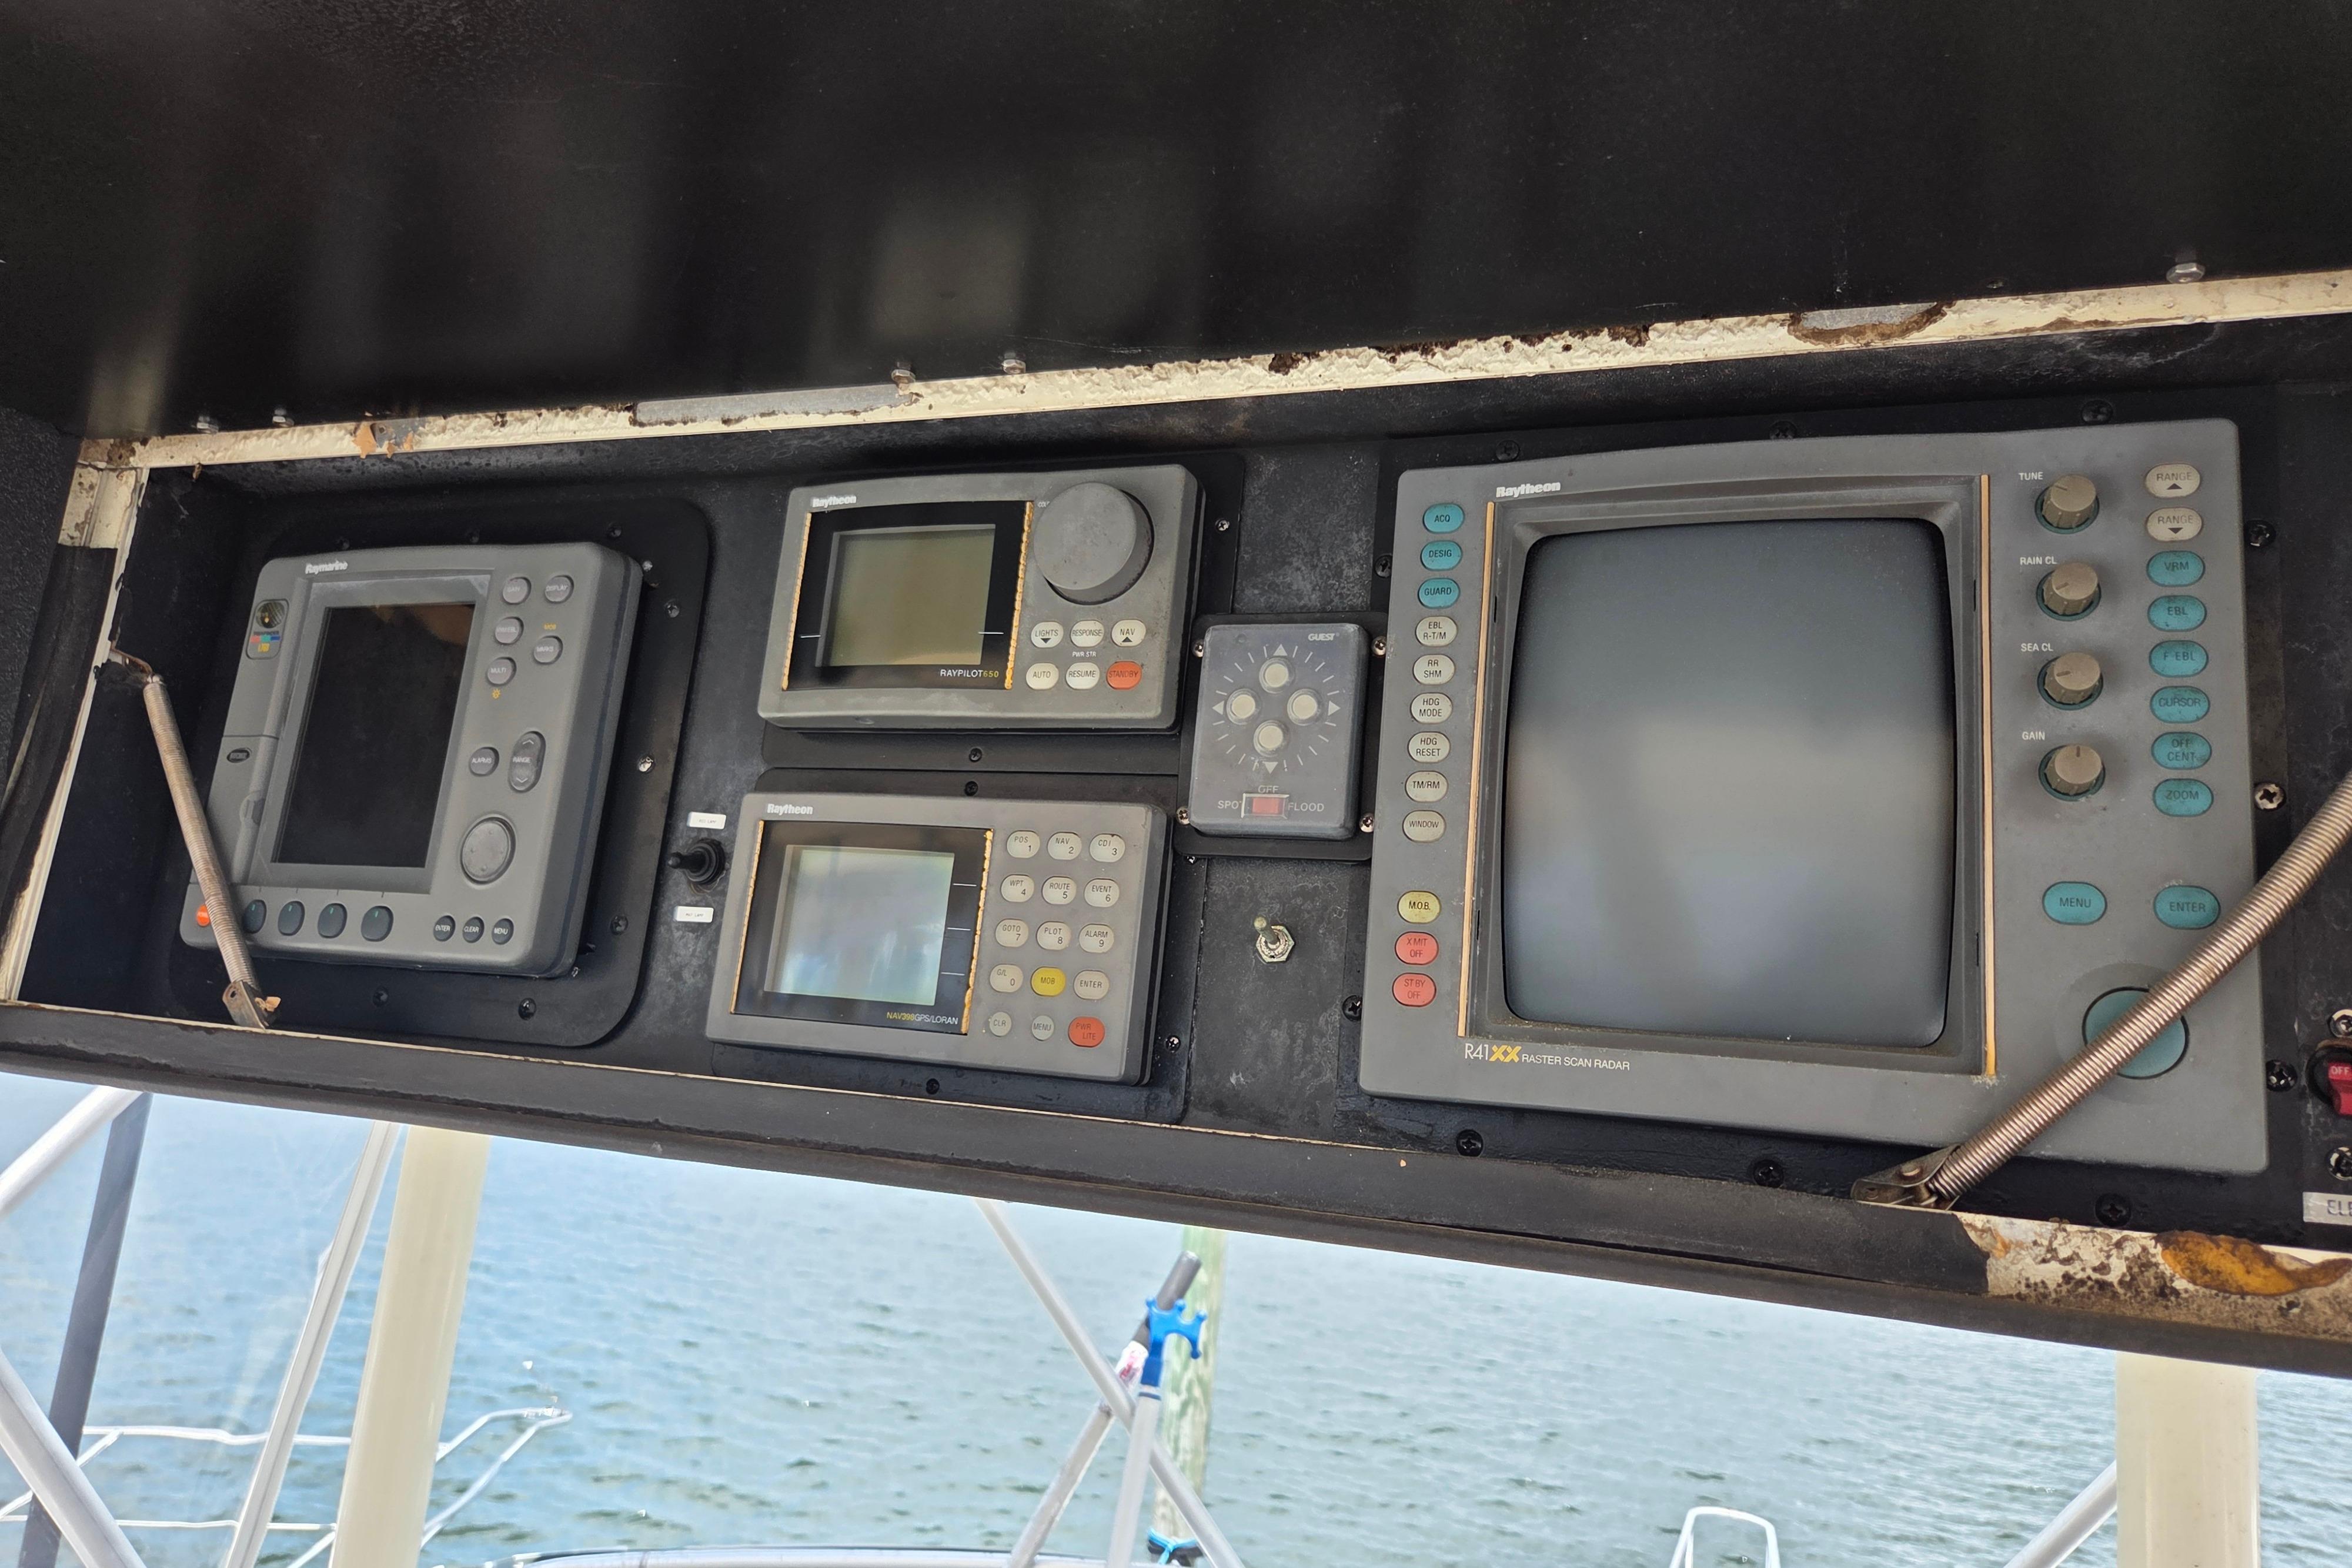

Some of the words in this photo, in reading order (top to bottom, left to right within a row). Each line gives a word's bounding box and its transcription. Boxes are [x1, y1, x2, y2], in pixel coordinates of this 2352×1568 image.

[2018, 472, 2043, 480] TUNE
[2156, 472, 2192, 481] RANGE
[1496, 482, 1561, 498] Raytheon
[812, 496, 857, 508] Raytheon
[1434, 514, 1451, 523] ACQ
[2157, 516, 2193, 524] RANGE
[1428, 550, 1452, 558] DESIG
[2020, 556, 2043, 565] RAIN
[2045, 556, 2057, 565] CL
[305, 560, 348, 574] Raymarine
[2164, 561, 2189, 570] VRM
[1424, 587, 1452, 596] GUARD
[2167, 606, 2188, 616] EBL
[1428, 621, 1443, 630] EBL
[1035, 629, 1058, 637] LIGHTS
[1423, 631, 1446, 641] R-T/M
[2021, 643, 2039, 652] SEA
[2041, 643, 2053, 652] CL
[1428, 660, 1439, 668] RR
[940, 669, 999, 677] RAYPILOT650
[1424, 670, 1442, 678] SHM
[1423, 698, 1439, 706] HDG
[2159, 697, 2201, 707] CURSOR
[1419, 708, 1442, 717] MODE
[2022, 731, 2046, 740] GAIN
[1420, 737, 1437, 746] HDG
[2171, 738, 2190, 748] OFF
[1416, 748, 1441, 757] RESET
[2167, 752, 2196, 761] CENT
[1258, 785, 1279, 793] OFF
[1412, 780, 1440, 789] TM/RM
[2166, 790, 2199, 800] ZOOM
[767, 803, 813, 815] Raytheon
[1217, 800, 1242, 809] SPO
[1288, 803, 1324, 811] FLOOD
[1409, 820, 1439, 828] WINDOW
[1408, 901, 1430, 911] M.O.B.
[2059, 897, 2092, 908] MENU
[2169, 901, 2206, 913] ENTER
[1409, 949, 1423, 958] OFF
[1040, 977, 1055, 985] MOB
[1407, 991, 1421, 999] OFF
[1033, 1022, 1051, 1031] MENU
[1465, 1043, 1522, 1063] R41XX
[1522, 1054, 1561, 1065] RASTER
[1563, 1057, 1592, 1068] SCAN
[1594, 1059, 1630, 1071] RADAR
[2331, 1065, 2350, 1075] OFF
